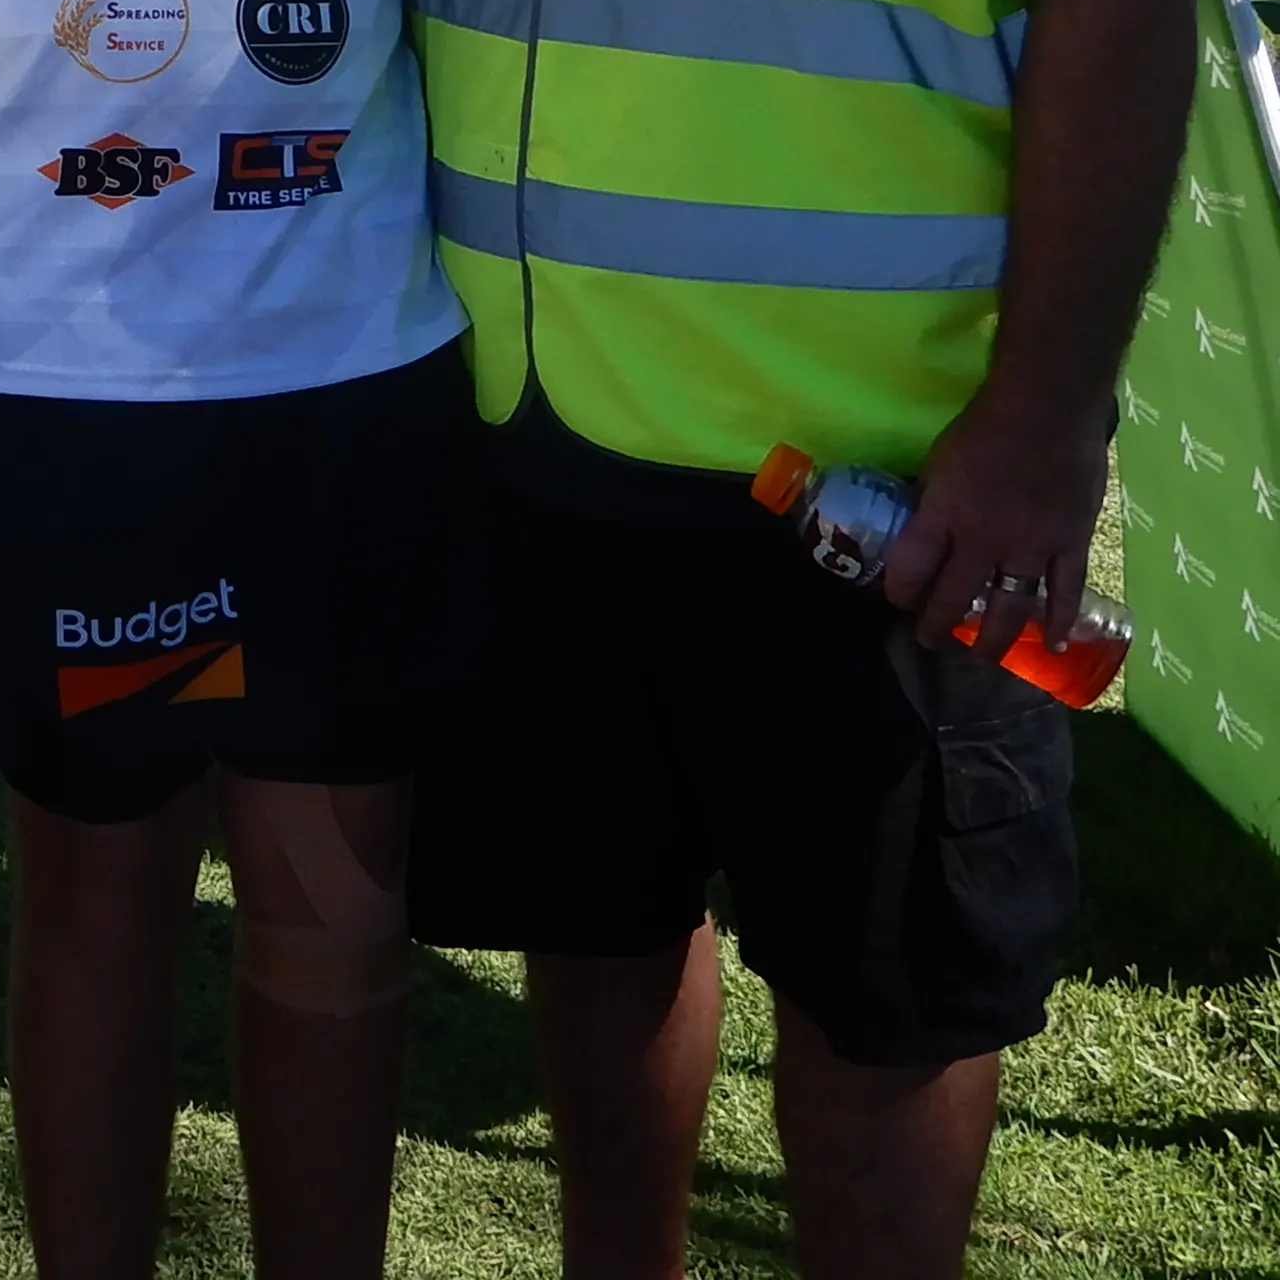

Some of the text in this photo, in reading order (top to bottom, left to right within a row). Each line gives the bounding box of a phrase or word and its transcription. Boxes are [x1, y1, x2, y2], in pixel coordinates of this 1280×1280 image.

[256, 1, 333, 35] CRI
[53, 146, 182, 198] BSF
[227, 191, 273, 206] TYRE
[55, 577, 239, 649] Budget
